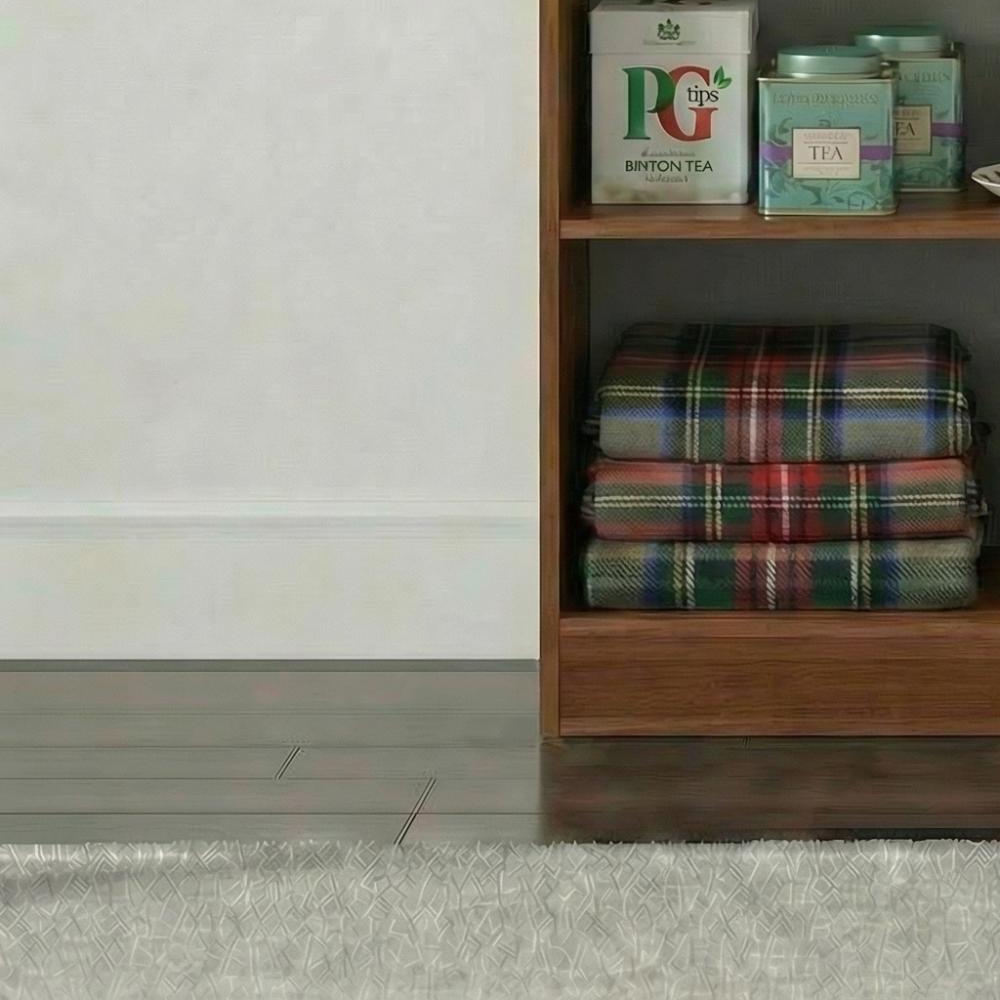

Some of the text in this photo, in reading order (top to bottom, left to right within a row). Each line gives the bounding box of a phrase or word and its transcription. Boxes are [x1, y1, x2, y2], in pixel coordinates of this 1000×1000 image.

[687, 85, 719, 106] tips
[622, 66, 718, 141] PG
[895, 121, 915, 136] EA
[808, 146, 843, 160] TEA
[625, 160, 713, 172] BINTON TEA
